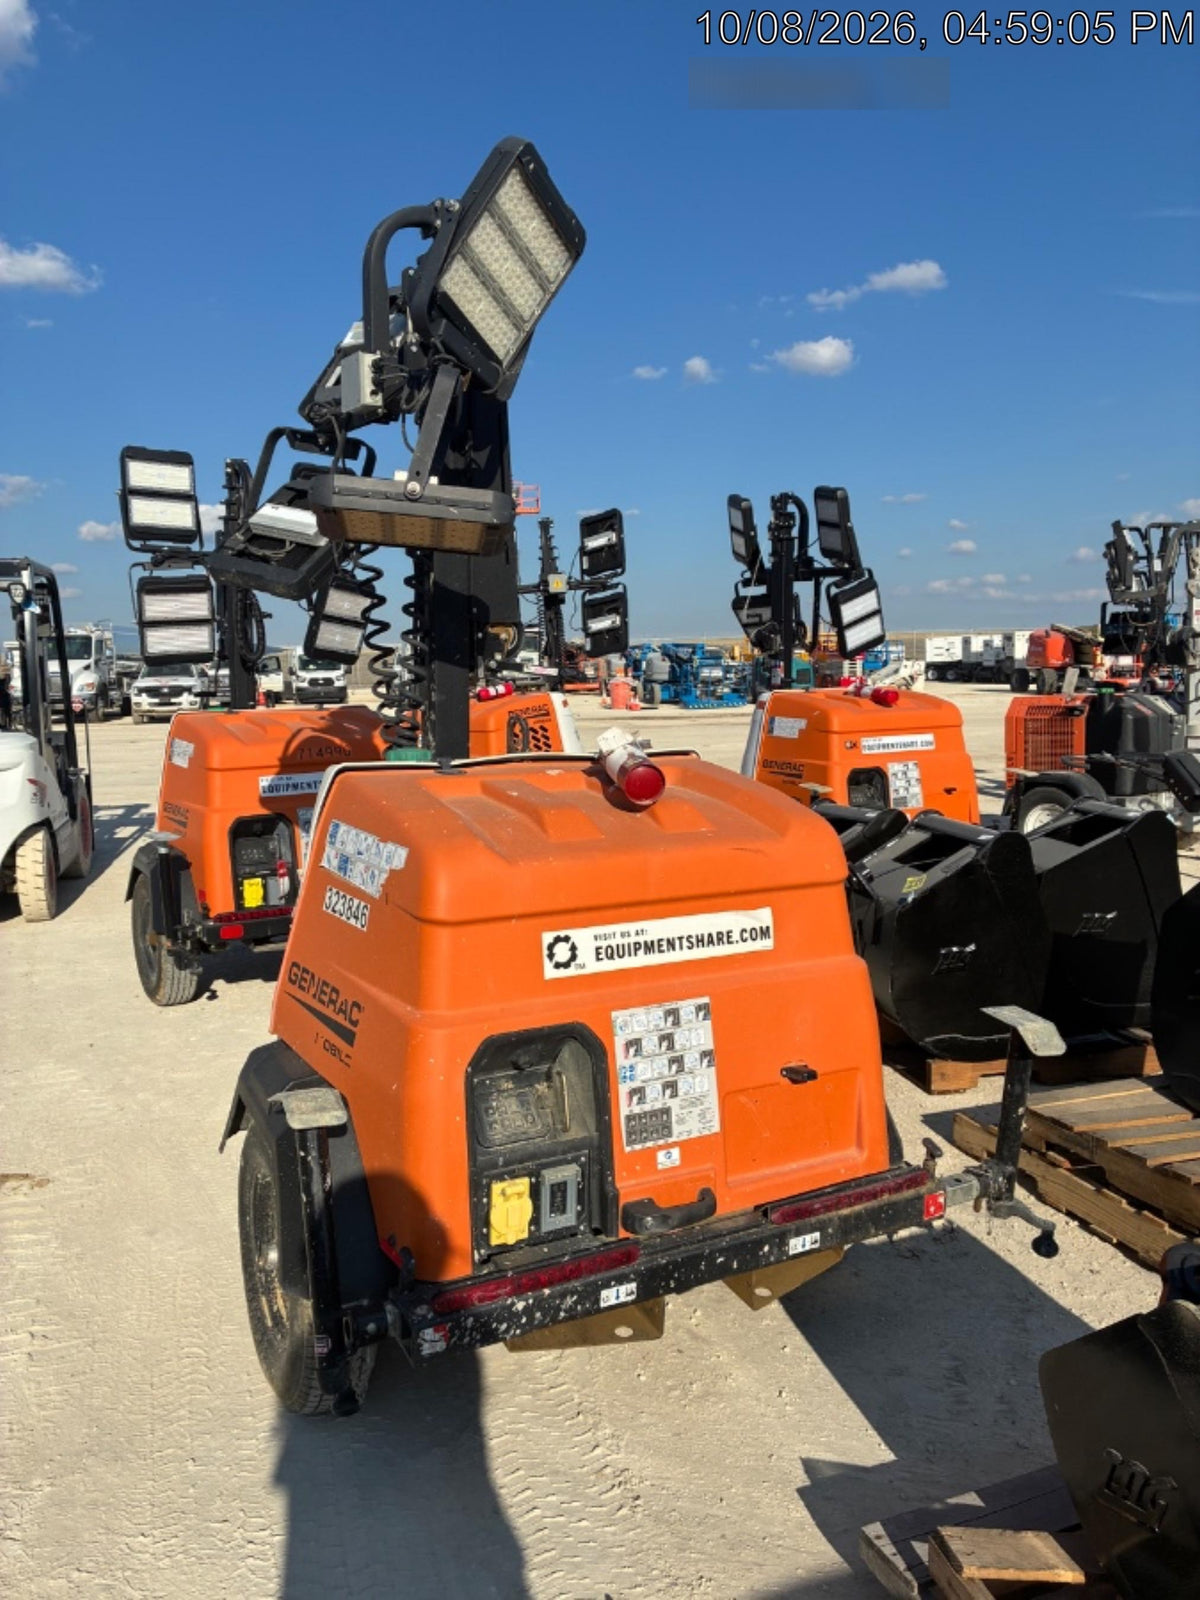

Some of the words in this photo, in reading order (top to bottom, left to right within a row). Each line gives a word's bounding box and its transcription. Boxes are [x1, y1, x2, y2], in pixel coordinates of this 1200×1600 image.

[261, 779, 322, 794] EQUIPMENT
[323, 886, 370, 930] 323846
[593, 931, 618, 942] VISIT
[620, 930, 632, 940] US
[634, 928, 648, 938] AT:
[594, 925, 772, 963] EQUIPMENTSHARE.COM
[287, 960, 363, 1029] GENERAC
